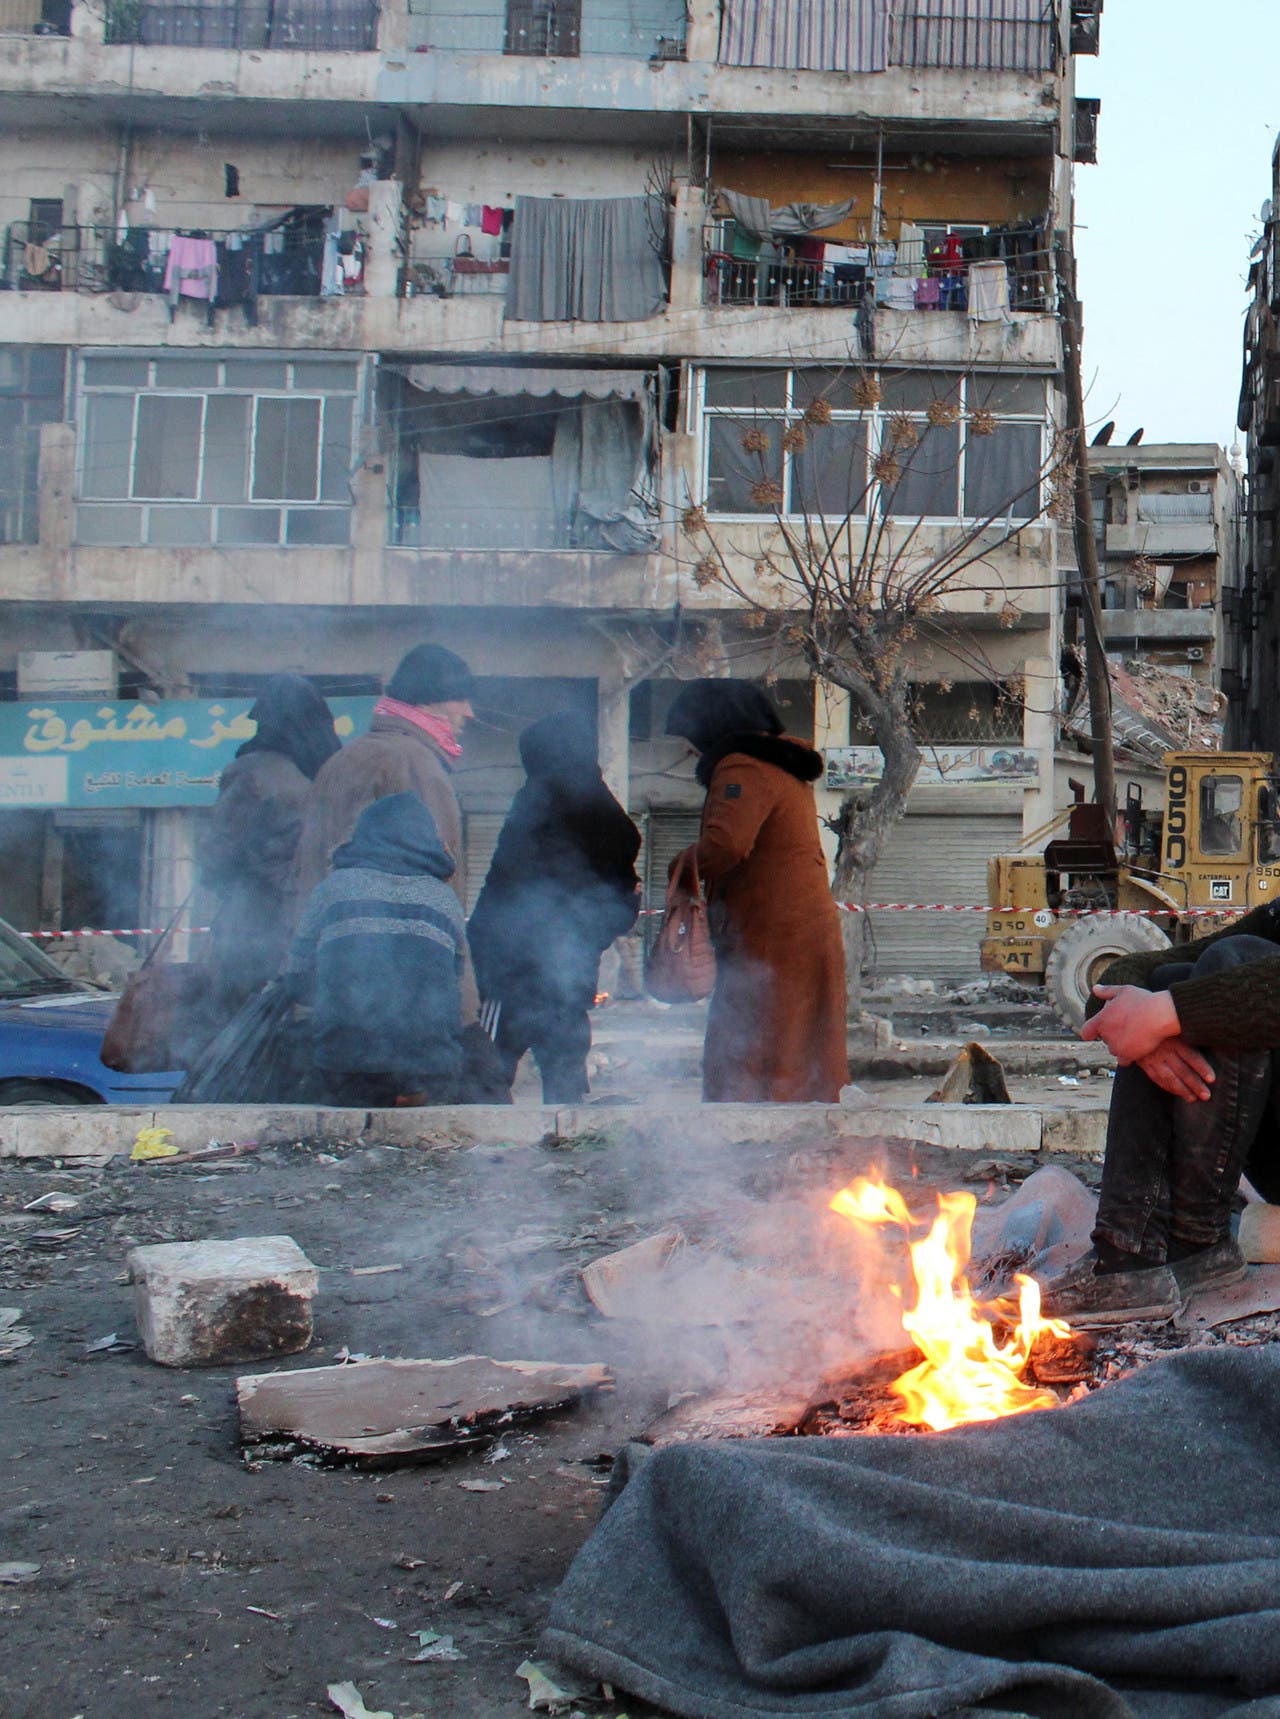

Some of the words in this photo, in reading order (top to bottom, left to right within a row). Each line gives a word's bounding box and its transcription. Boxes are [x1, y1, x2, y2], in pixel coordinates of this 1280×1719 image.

[24, 704, 187, 752] مشنوق
[1166, 766, 1187, 868] 950
[1256, 867, 1280, 877] 950
[1213, 885, 1229, 897] CAT
[1036, 915, 1047, 923] 40
[1001, 952, 1033, 968] AT
